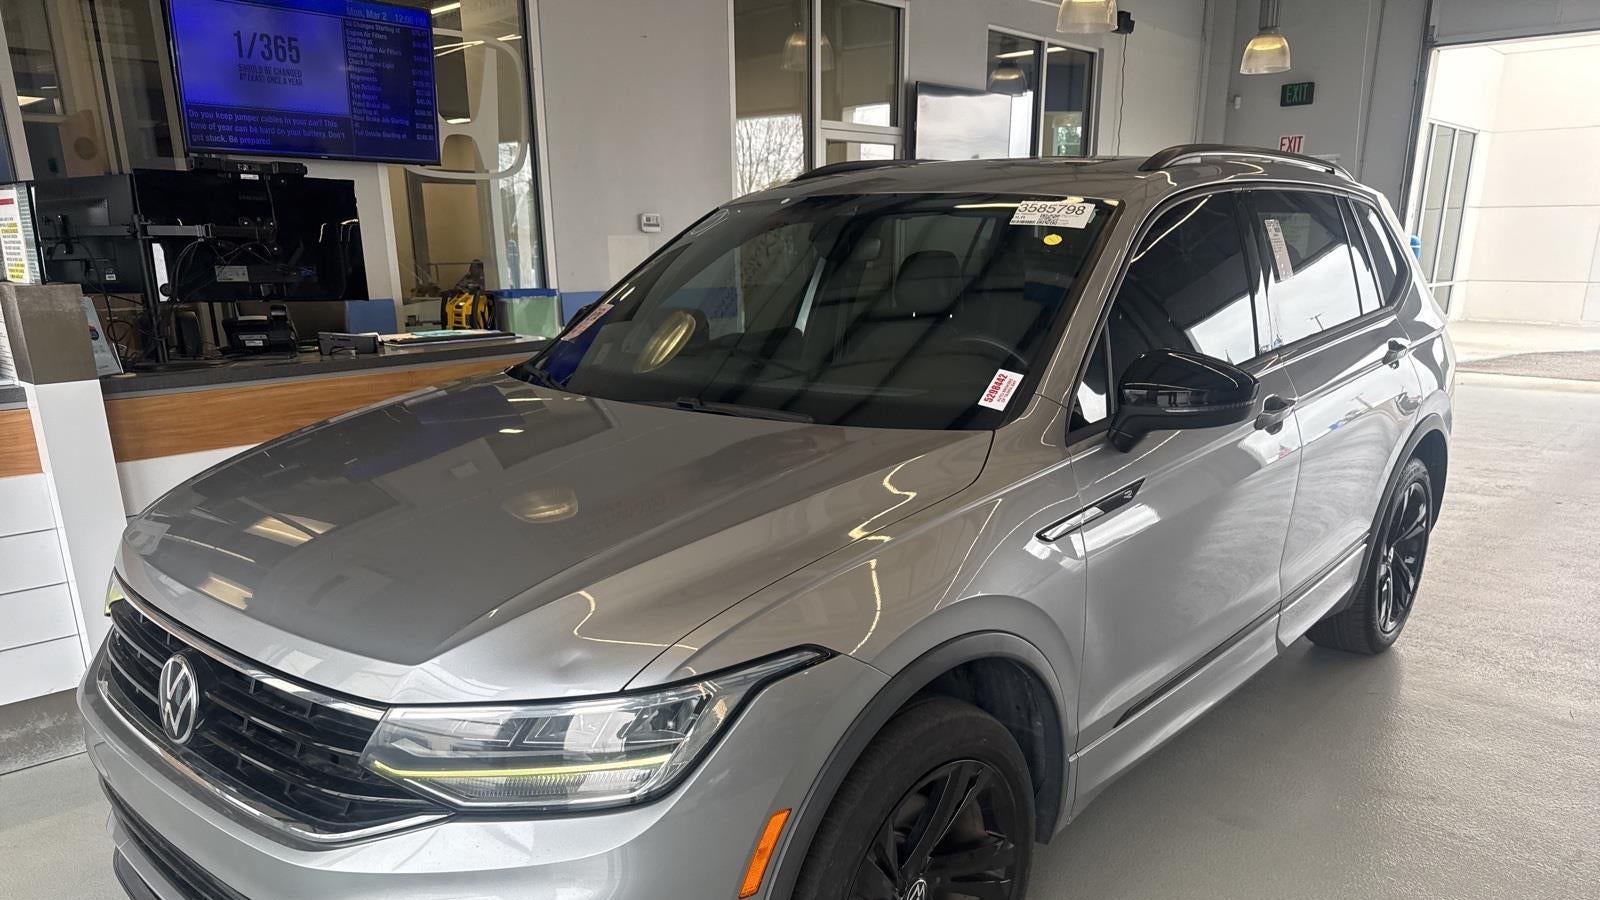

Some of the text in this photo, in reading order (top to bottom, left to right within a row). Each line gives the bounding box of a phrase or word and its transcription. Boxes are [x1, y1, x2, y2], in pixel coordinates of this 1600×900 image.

[366, 10, 380, 19] Mar
[375, 24, 395, 33] Starting
[233, 30, 300, 64] 1/365
[239, 64, 302, 77] SHOULD BE CHANGED
[1286, 84, 1308, 103] EXIT
[189, 110, 198, 118] Do
[216, 111, 232, 121] keep
[235, 113, 258, 122] jumper
[205, 134, 227, 142] stuck.
[240, 136, 272, 145] prepared.
[1280, 136, 1304, 153] EXIT
[1018, 203, 1086, 216] 3585798
[984, 374, 1008, 402] 5298442
